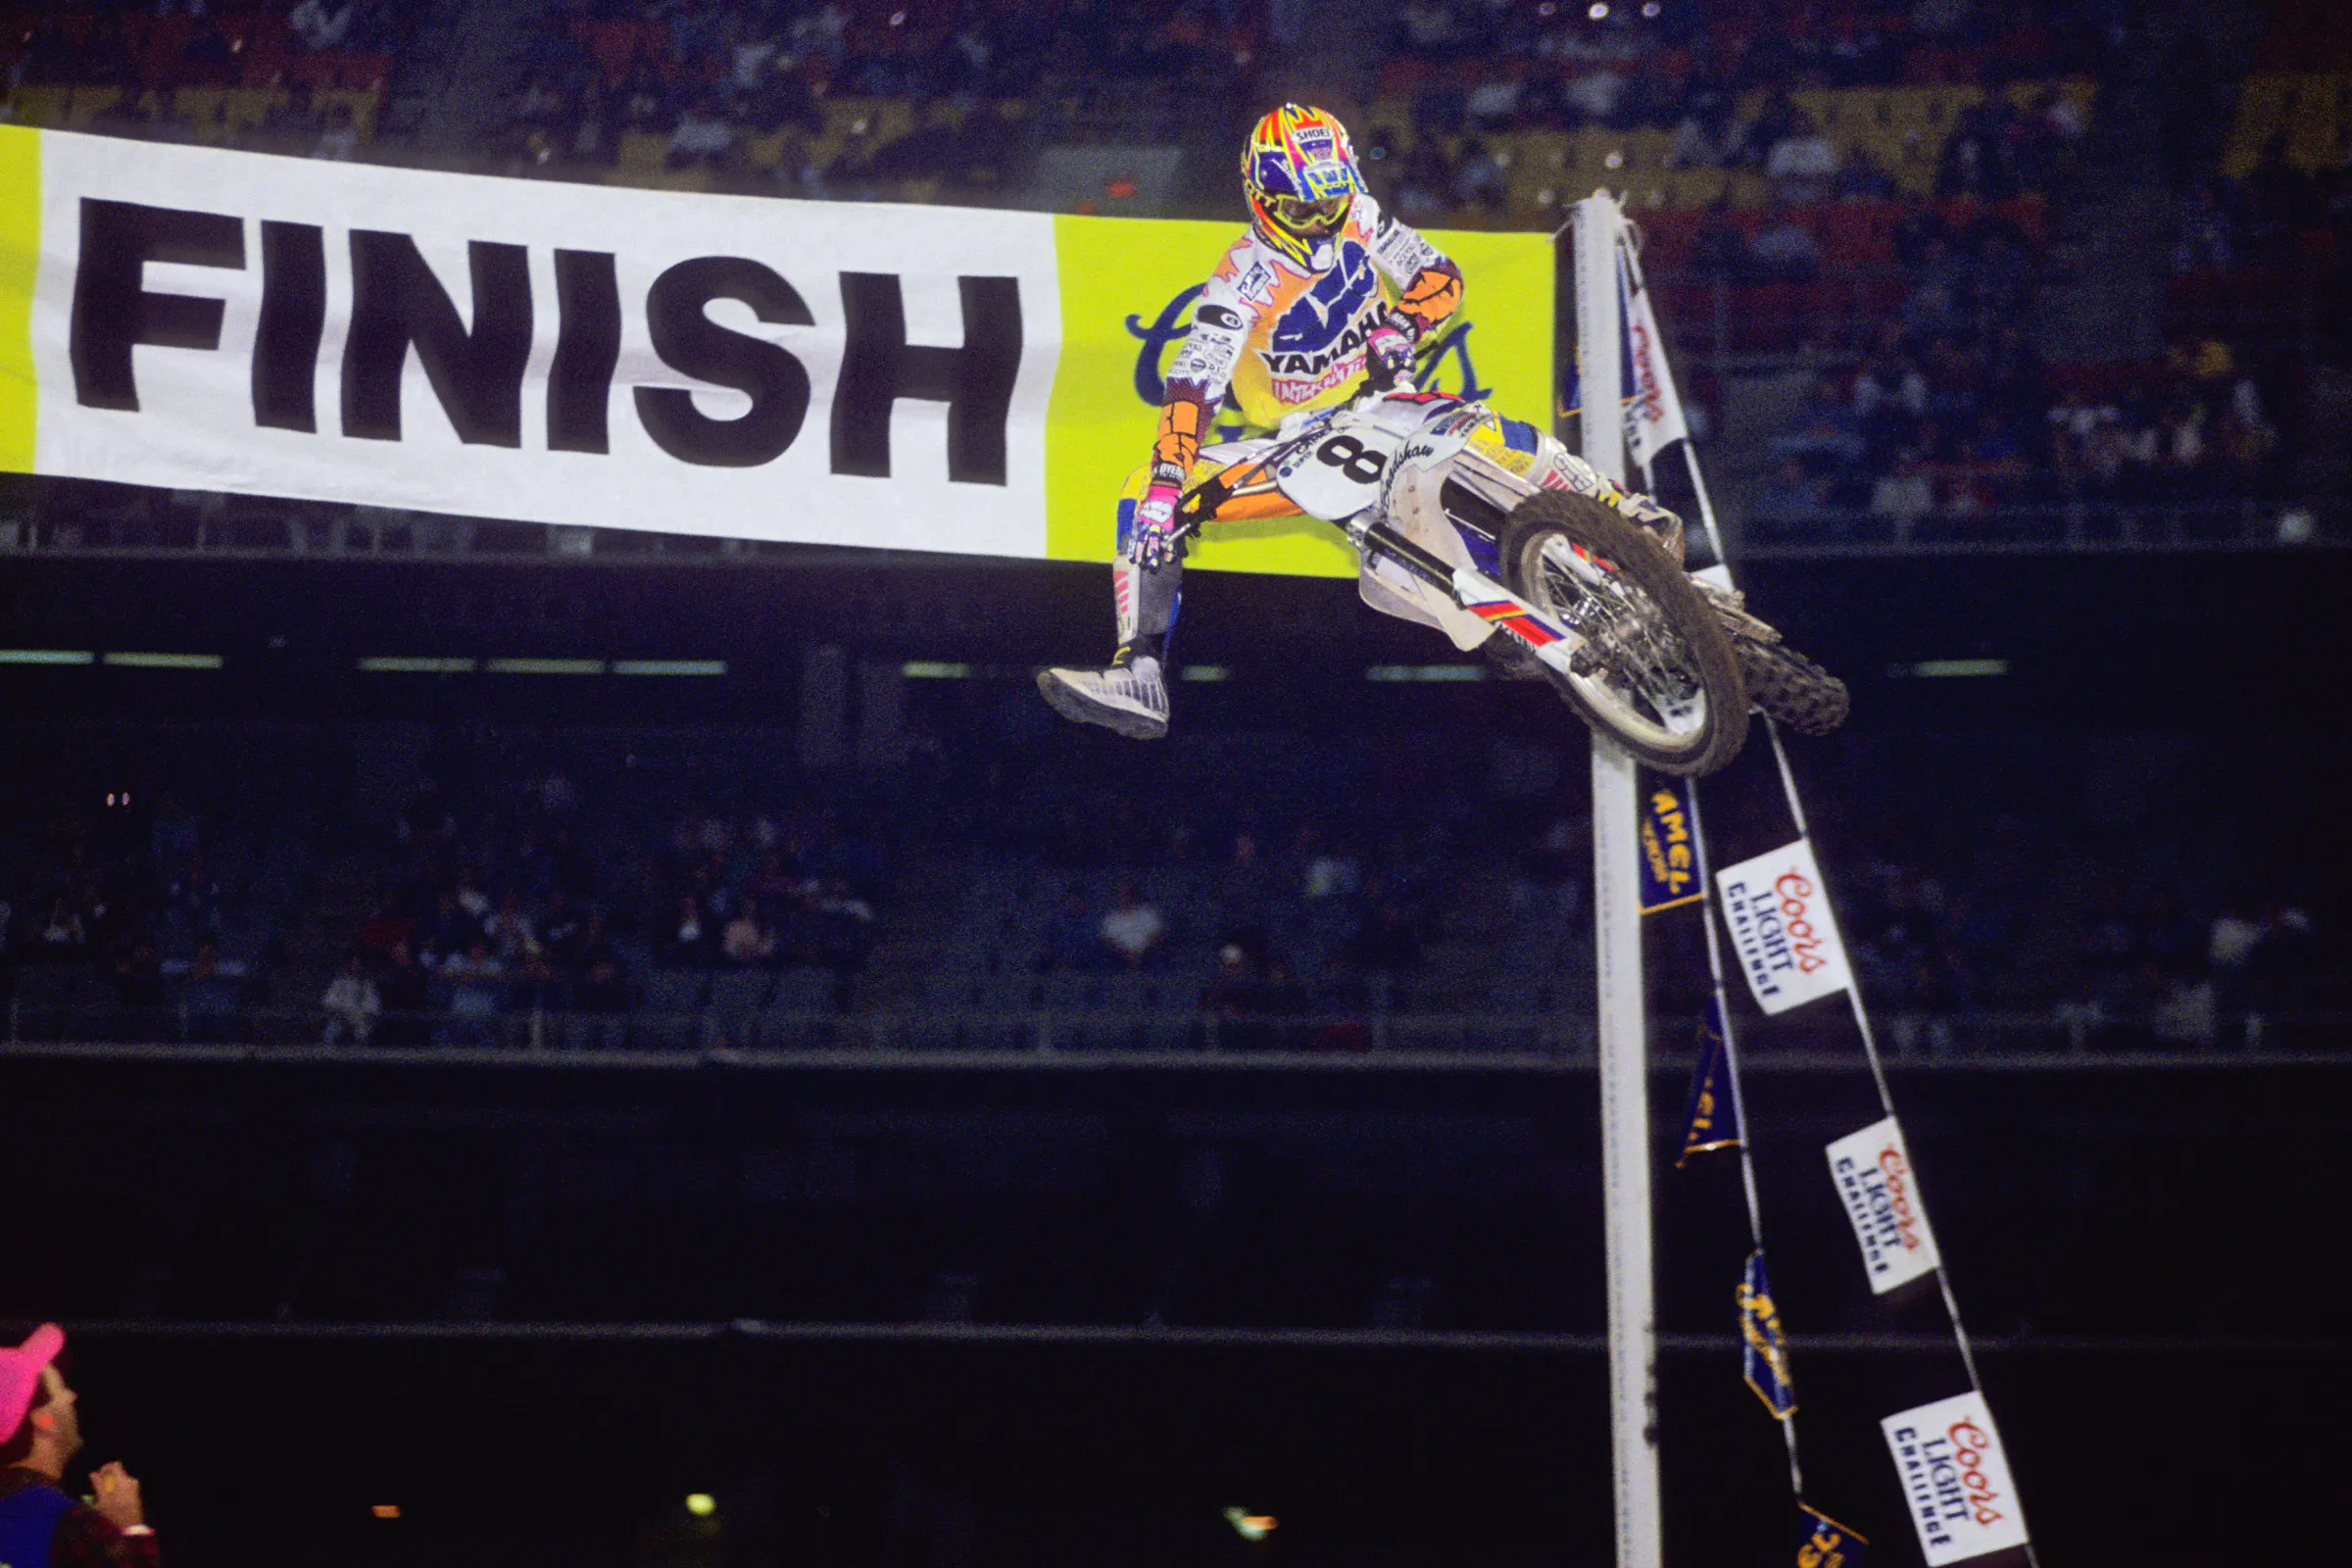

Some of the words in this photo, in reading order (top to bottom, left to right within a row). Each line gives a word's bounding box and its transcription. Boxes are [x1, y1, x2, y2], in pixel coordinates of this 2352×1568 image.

[1296, 126, 1331, 141] SHOEI
[68, 196, 1024, 487] FINISH
[1316, 434, 1388, 484] 8
[1650, 788, 1690, 894] AMEL
[1750, 892, 1793, 971] LIGHT
[1775, 866, 1827, 973] Coors
[1859, 1168, 1901, 1247] LIGHT
[1878, 1143, 1920, 1251] Coors
[1922, 1439, 1971, 1520] LIGHT
[1947, 1416, 2004, 1525] Coors
